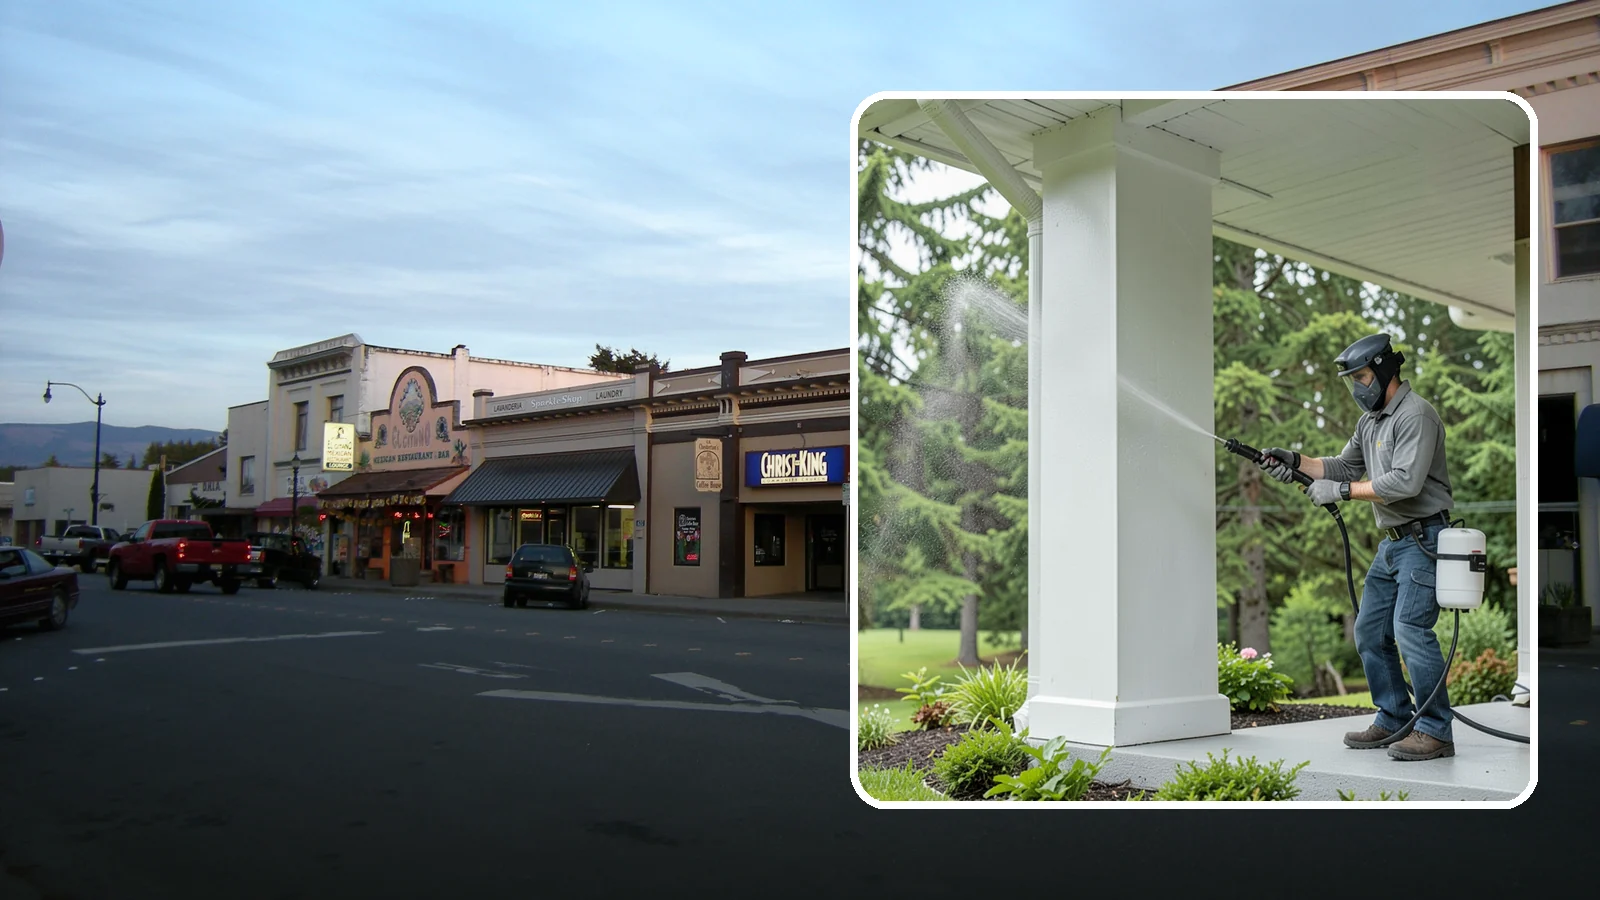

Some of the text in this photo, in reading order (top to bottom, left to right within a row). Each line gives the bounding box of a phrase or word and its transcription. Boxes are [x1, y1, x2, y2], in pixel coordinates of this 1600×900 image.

[531, 394, 582, 408] Sparkle Shop
[596, 389, 624, 400] LAUNDRY
[494, 402, 522, 412] LAVANDERIA
[373, 450, 450, 464] MEXICAN RESTAURANT BAR
[761, 450, 828, 477] CHRIST KING
